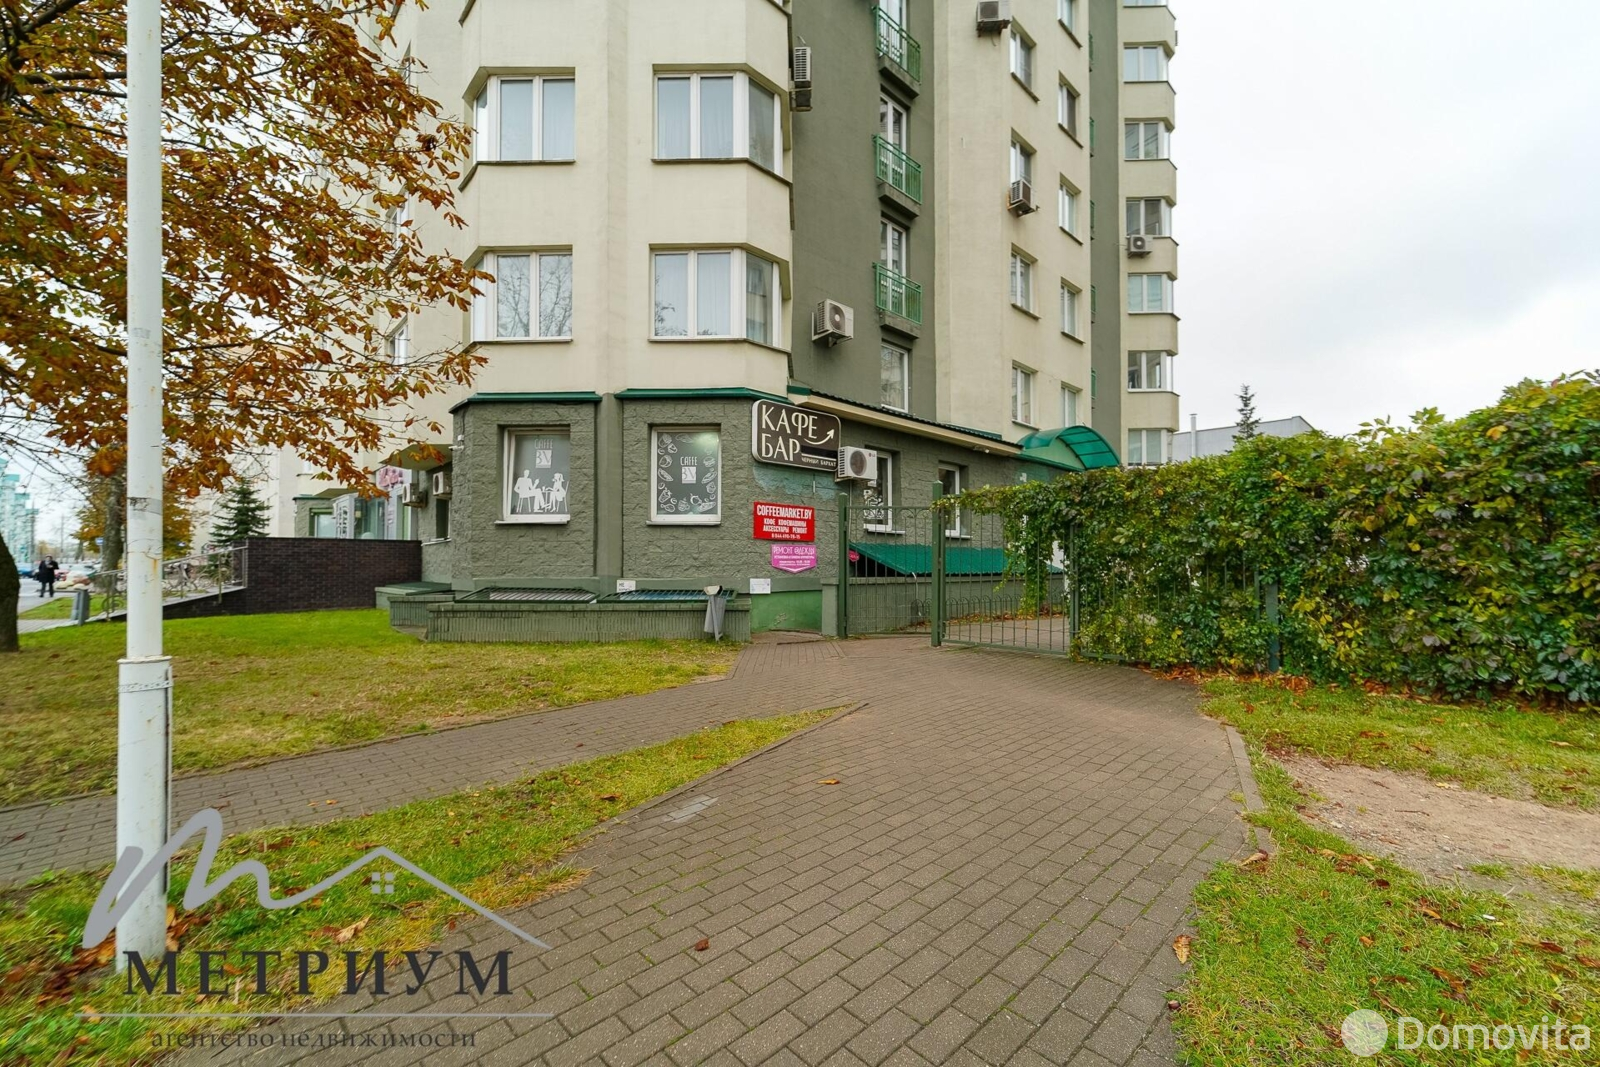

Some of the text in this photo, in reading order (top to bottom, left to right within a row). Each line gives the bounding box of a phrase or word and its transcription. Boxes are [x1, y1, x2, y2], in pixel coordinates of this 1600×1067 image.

[761, 404, 818, 439] КАФЕ
[534, 438, 553, 449] CAFFE
[761, 433, 800, 461] БАР
[680, 456, 698, 466] CAFFE
[757, 505, 812, 519] COFFEEMARKET.BY
